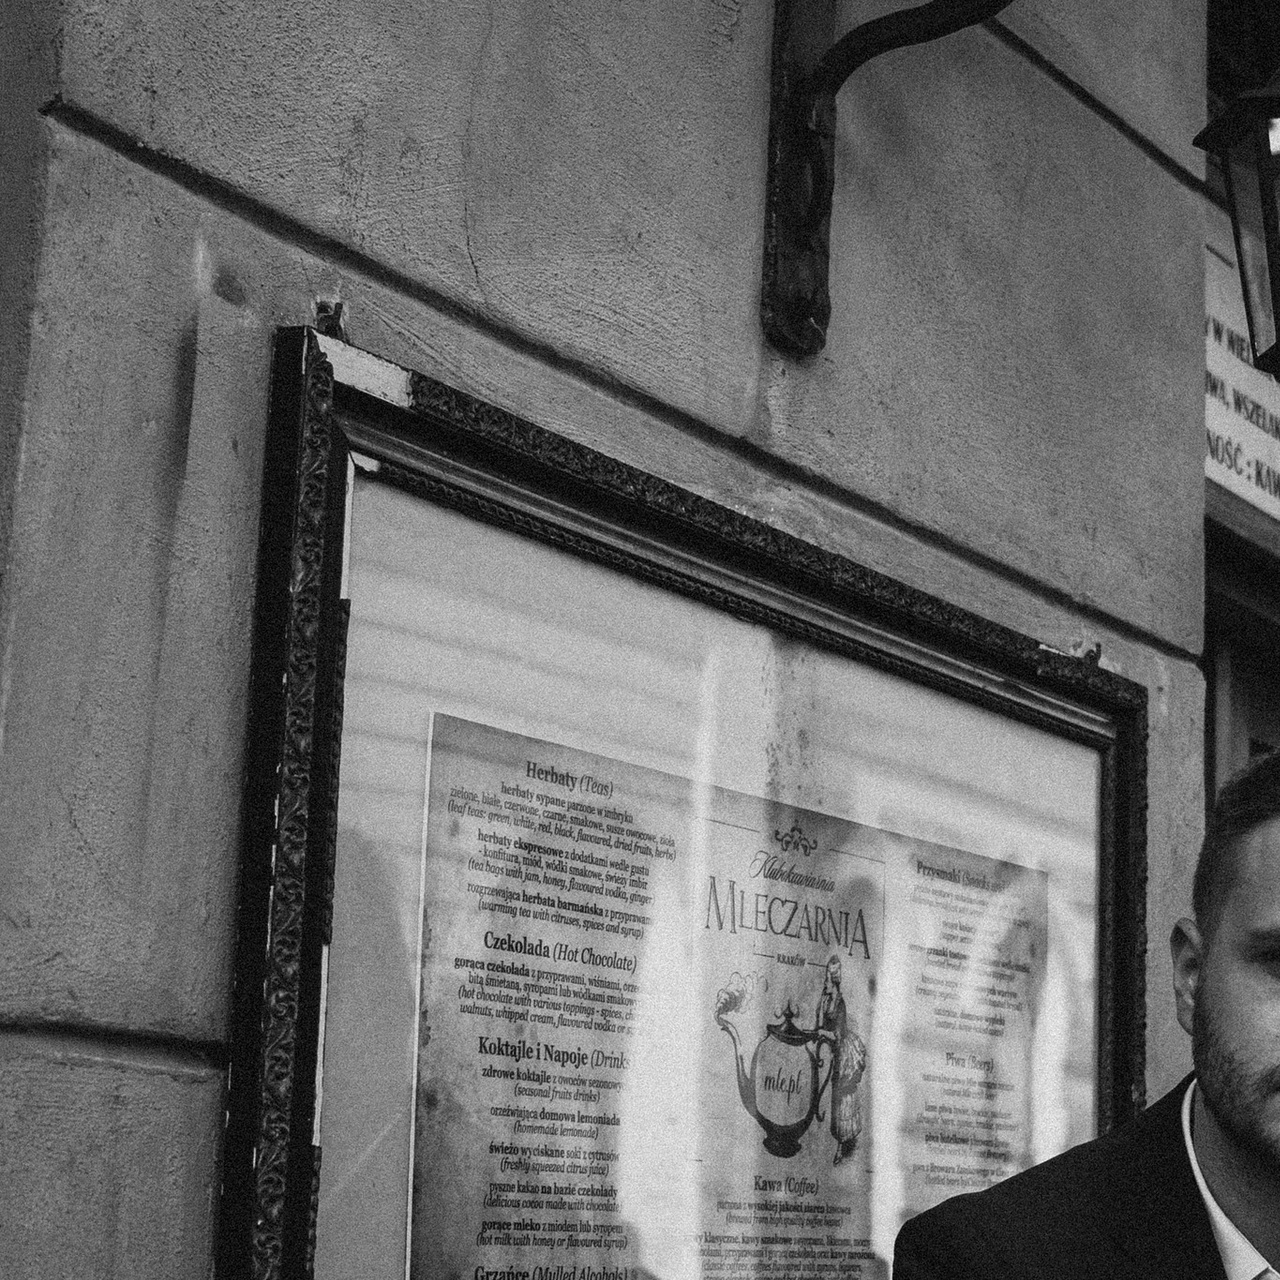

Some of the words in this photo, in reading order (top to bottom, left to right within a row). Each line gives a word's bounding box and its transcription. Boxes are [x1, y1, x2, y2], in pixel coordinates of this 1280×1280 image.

[526, 761, 577, 792] Herbaty
[580, 775, 613, 800] (Teas)
[501, 781, 534, 803] herbaty
[536, 793, 565, 808] sypane
[448, 799, 468, 817] (leaf
[467, 805, 487, 819] teas:
[488, 812, 512, 827] green,
[538, 822, 553, 836] red,
[554, 823, 576, 841] black,
[478, 828, 512, 850] herbaty
[513, 837, 563, 859] ekspresowe
[570, 849, 609, 868] dodatkami
[522, 854, 544, 871] miód,
[545, 860, 568, 874] wódki
[468, 857, 484, 871] (tea
[485, 860, 504, 878] bags
[505, 865, 522, 880] with
[522, 869, 542, 884] jam,
[543, 872, 568, 890] honey,
[568, 877, 605, 895] flavoured
[605, 886, 628, 903] vodka,
[522, 889, 556, 908] herbata
[557, 896, 603, 917] barmańska
[479, 899, 518, 919] (warming
[519, 906, 531, 918] tea
[533, 908, 550, 922] with
[582, 918, 604, 932] spices
[605, 922, 620, 934] and
[620, 926, 644, 941] syrup)
[704, 875, 871, 959] MLECZARNIA
[484, 931, 550, 958] Czekolada
[553, 942, 579, 963] (Hot
[580, 947, 637, 976] Chocolate)
[454, 957, 485, 971] gorąca
[486, 960, 530, 977] czekolada
[537, 970, 586, 987] przyprawami,
[458, 985, 475, 1000] (hot
[476, 986, 513, 1004] chocolate
[514, 993, 532, 1007] with
[533, 997, 561, 1011] various
[562, 1002, 595, 1019] toppings
[559, 984, 571, 998] lub
[495, 1006, 529, 1024] whipped
[530, 1013, 556, 1028] cream,
[555, 1013, 593, 1031] flavoured
[594, 1019, 616, 1033] vodka
[478, 1036, 534, 1063] Koktajle
[536, 1042, 541, 1060] i
[543, 1044, 588, 1069] Napoje
[482, 1064, 515, 1080] zdrowe
[516, 1067, 551, 1085] koktajle
[514, 1083, 551, 1098] (seasonal
[550, 1086, 572, 1102] fruits
[573, 1088, 600, 1104] drinks)
[540, 1107, 576, 1122] domowa
[577, 1110, 620, 1126] lemoniada
[514, 1120, 558, 1136] (homemade
[560, 1123, 599, 1140] lemonade)
[489, 1140, 519, 1156] świeżo
[520, 1144, 565, 1159] wyciskane
[500, 1156, 531, 1174] (freshly
[531, 1160, 565, 1175] squeezed
[566, 1162, 588, 1174] citrus
[489, 1182, 516, 1196] pyszne
[517, 1180, 540, 1194] kakao
[541, 1185, 552, 1195] na
[553, 1182, 576, 1196] bazie
[577, 1184, 618, 1201] czekolady
[754, 1175, 782, 1192] Kawa
[784, 1176, 819, 1197] (Coffee)
[483, 1193, 521, 1208] (delicious
[522, 1200, 544, 1209] cocoa
[545, 1197, 567, 1210] made
[568, 1198, 585, 1211] with
[481, 1220, 512, 1233] gorące
[513, 1218, 541, 1232] mleko
[548, 1219, 578, 1233] miodem
[579, 1219, 591, 1233] lub
[476, 1231, 493, 1248] (hot
[494, 1232, 512, 1246] milk
[513, 1233, 531, 1247] with
[532, 1234, 555, 1250] honey
[556, 1238, 567, 1247] or
[566, 1234, 603, 1250] flavoured
[603, 1236, 628, 1251] syrup)
